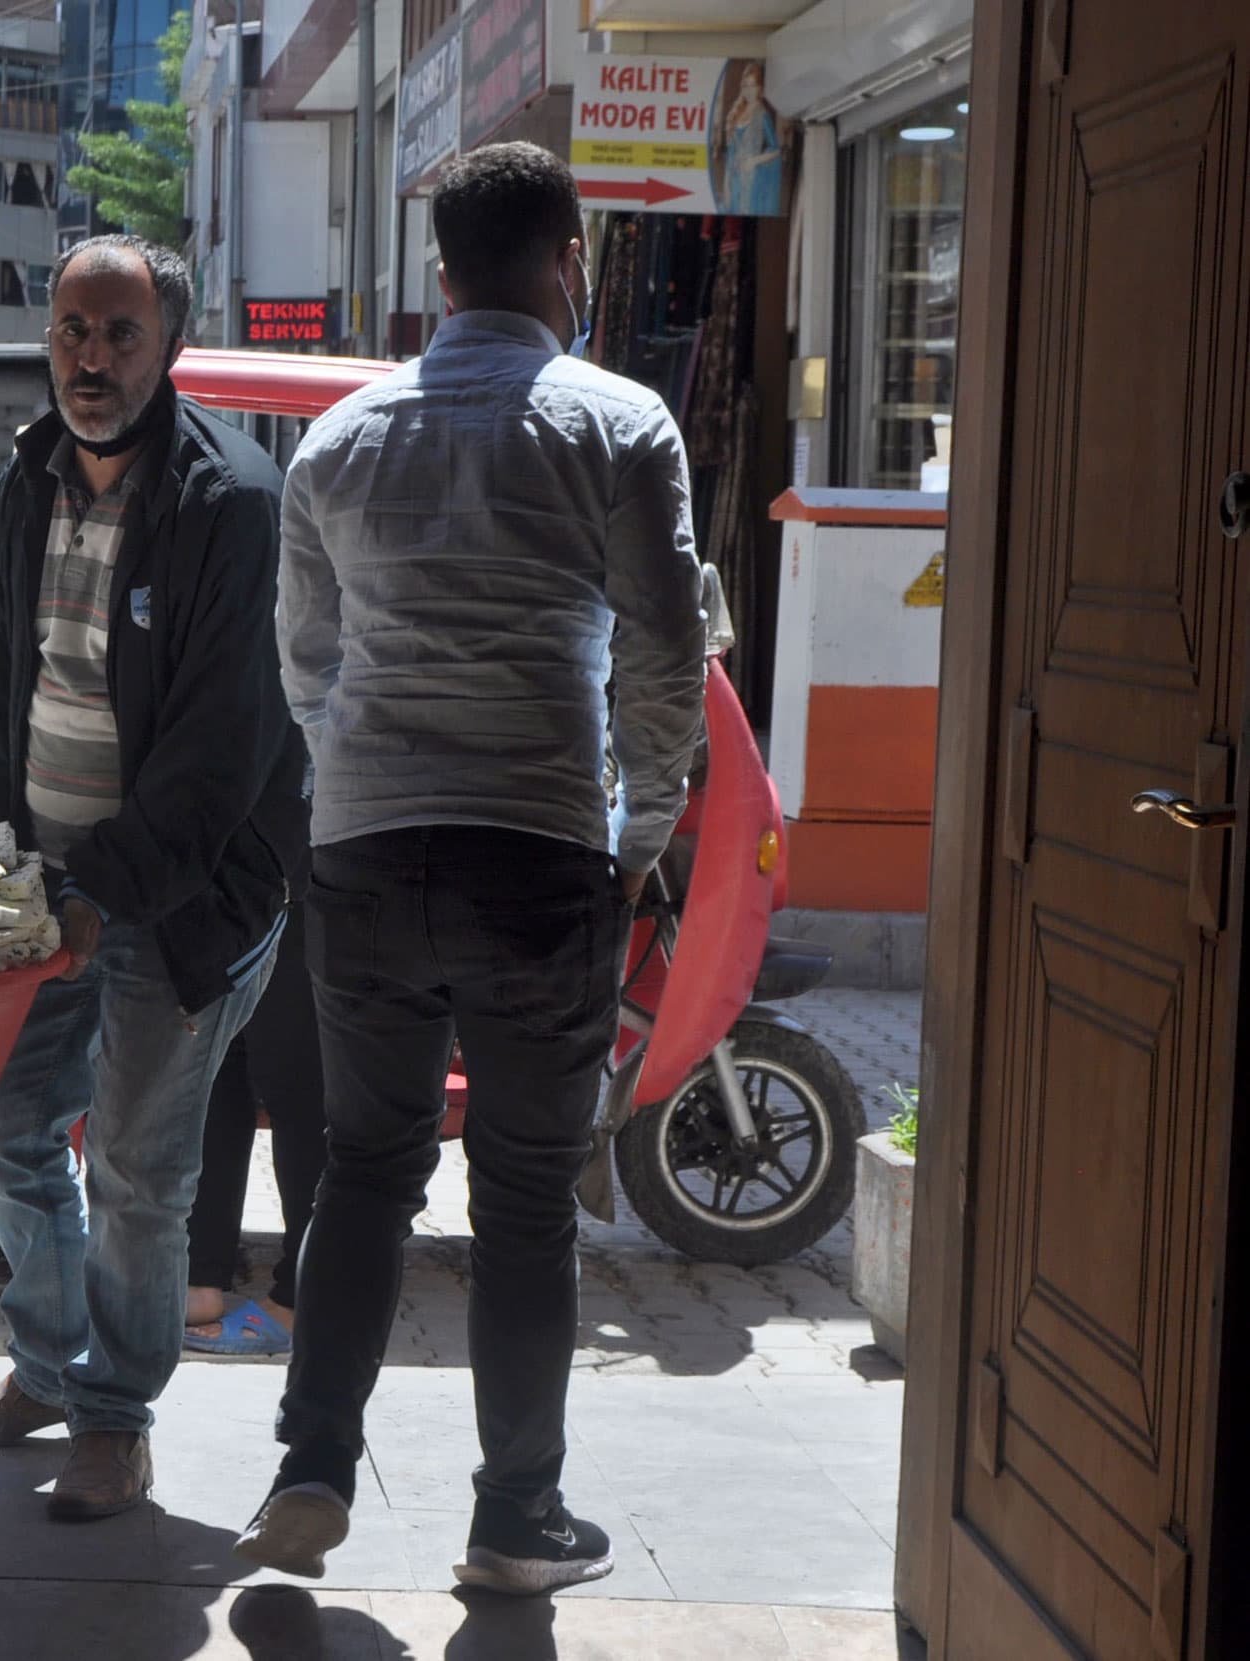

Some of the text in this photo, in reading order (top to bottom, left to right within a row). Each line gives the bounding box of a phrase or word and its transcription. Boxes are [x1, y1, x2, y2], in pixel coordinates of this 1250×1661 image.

[600, 63, 690, 94] KALİTE
[580, 101, 706, 132] MODA EVİ
